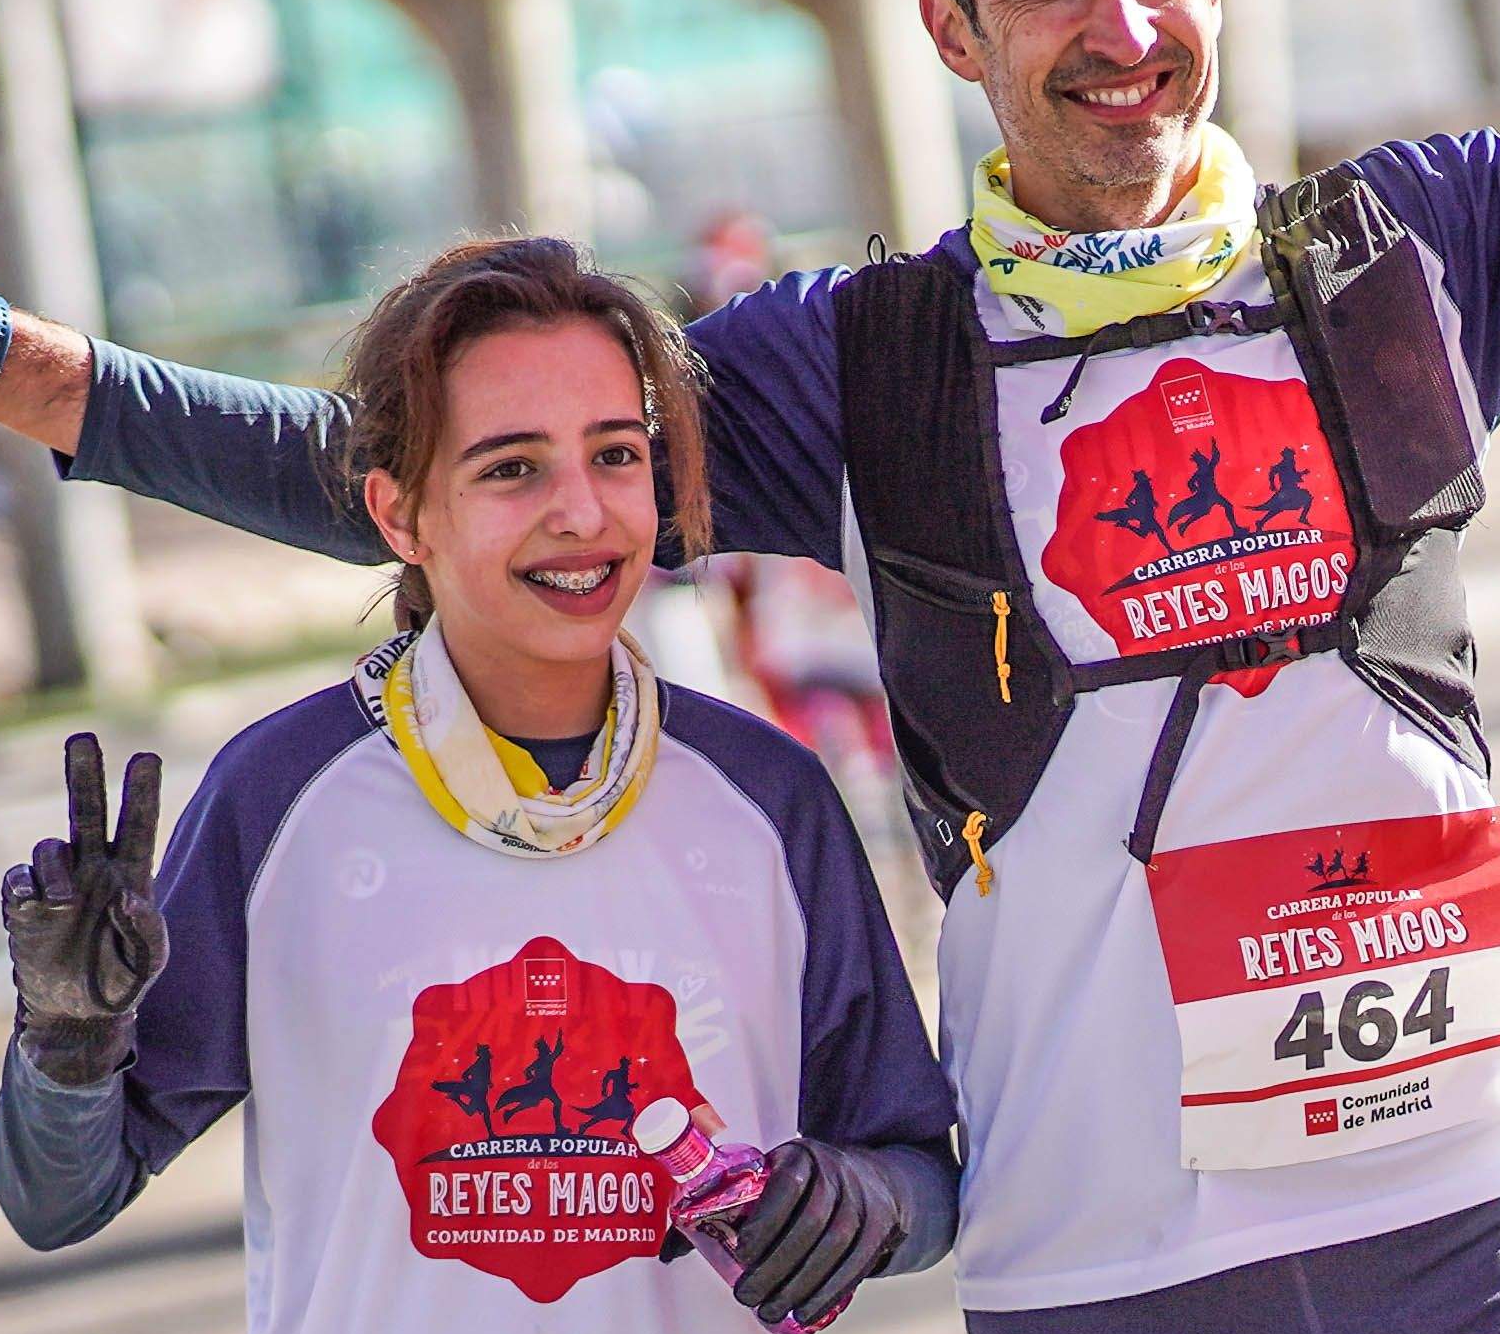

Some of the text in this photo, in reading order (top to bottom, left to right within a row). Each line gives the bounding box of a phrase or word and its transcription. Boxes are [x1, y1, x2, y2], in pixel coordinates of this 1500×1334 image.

[1133, 528, 1323, 581] CARRERA POPULAR
[1214, 560, 1246, 576] de los
[1121, 580, 1229, 639] REYES
[1237, 552, 1349, 616] MAGOS
[1267, 889, 1423, 920] CARRERA POPULAR
[1332, 910, 1342, 921] de
[1238, 903, 1468, 981] REYES MAGOS
[1274, 967, 1455, 1071] 464
[1343, 1077, 1430, 1110] Comunidad
[1343, 1095, 1433, 1130] de Madrid
[449, 1137, 639, 1159] CARRERA POPULAR
[527, 1159, 560, 1170] de los
[428, 1171, 655, 1217] REYES MAGOS
[426, 1226, 656, 1244] COMUNIDAD DE MADRID
